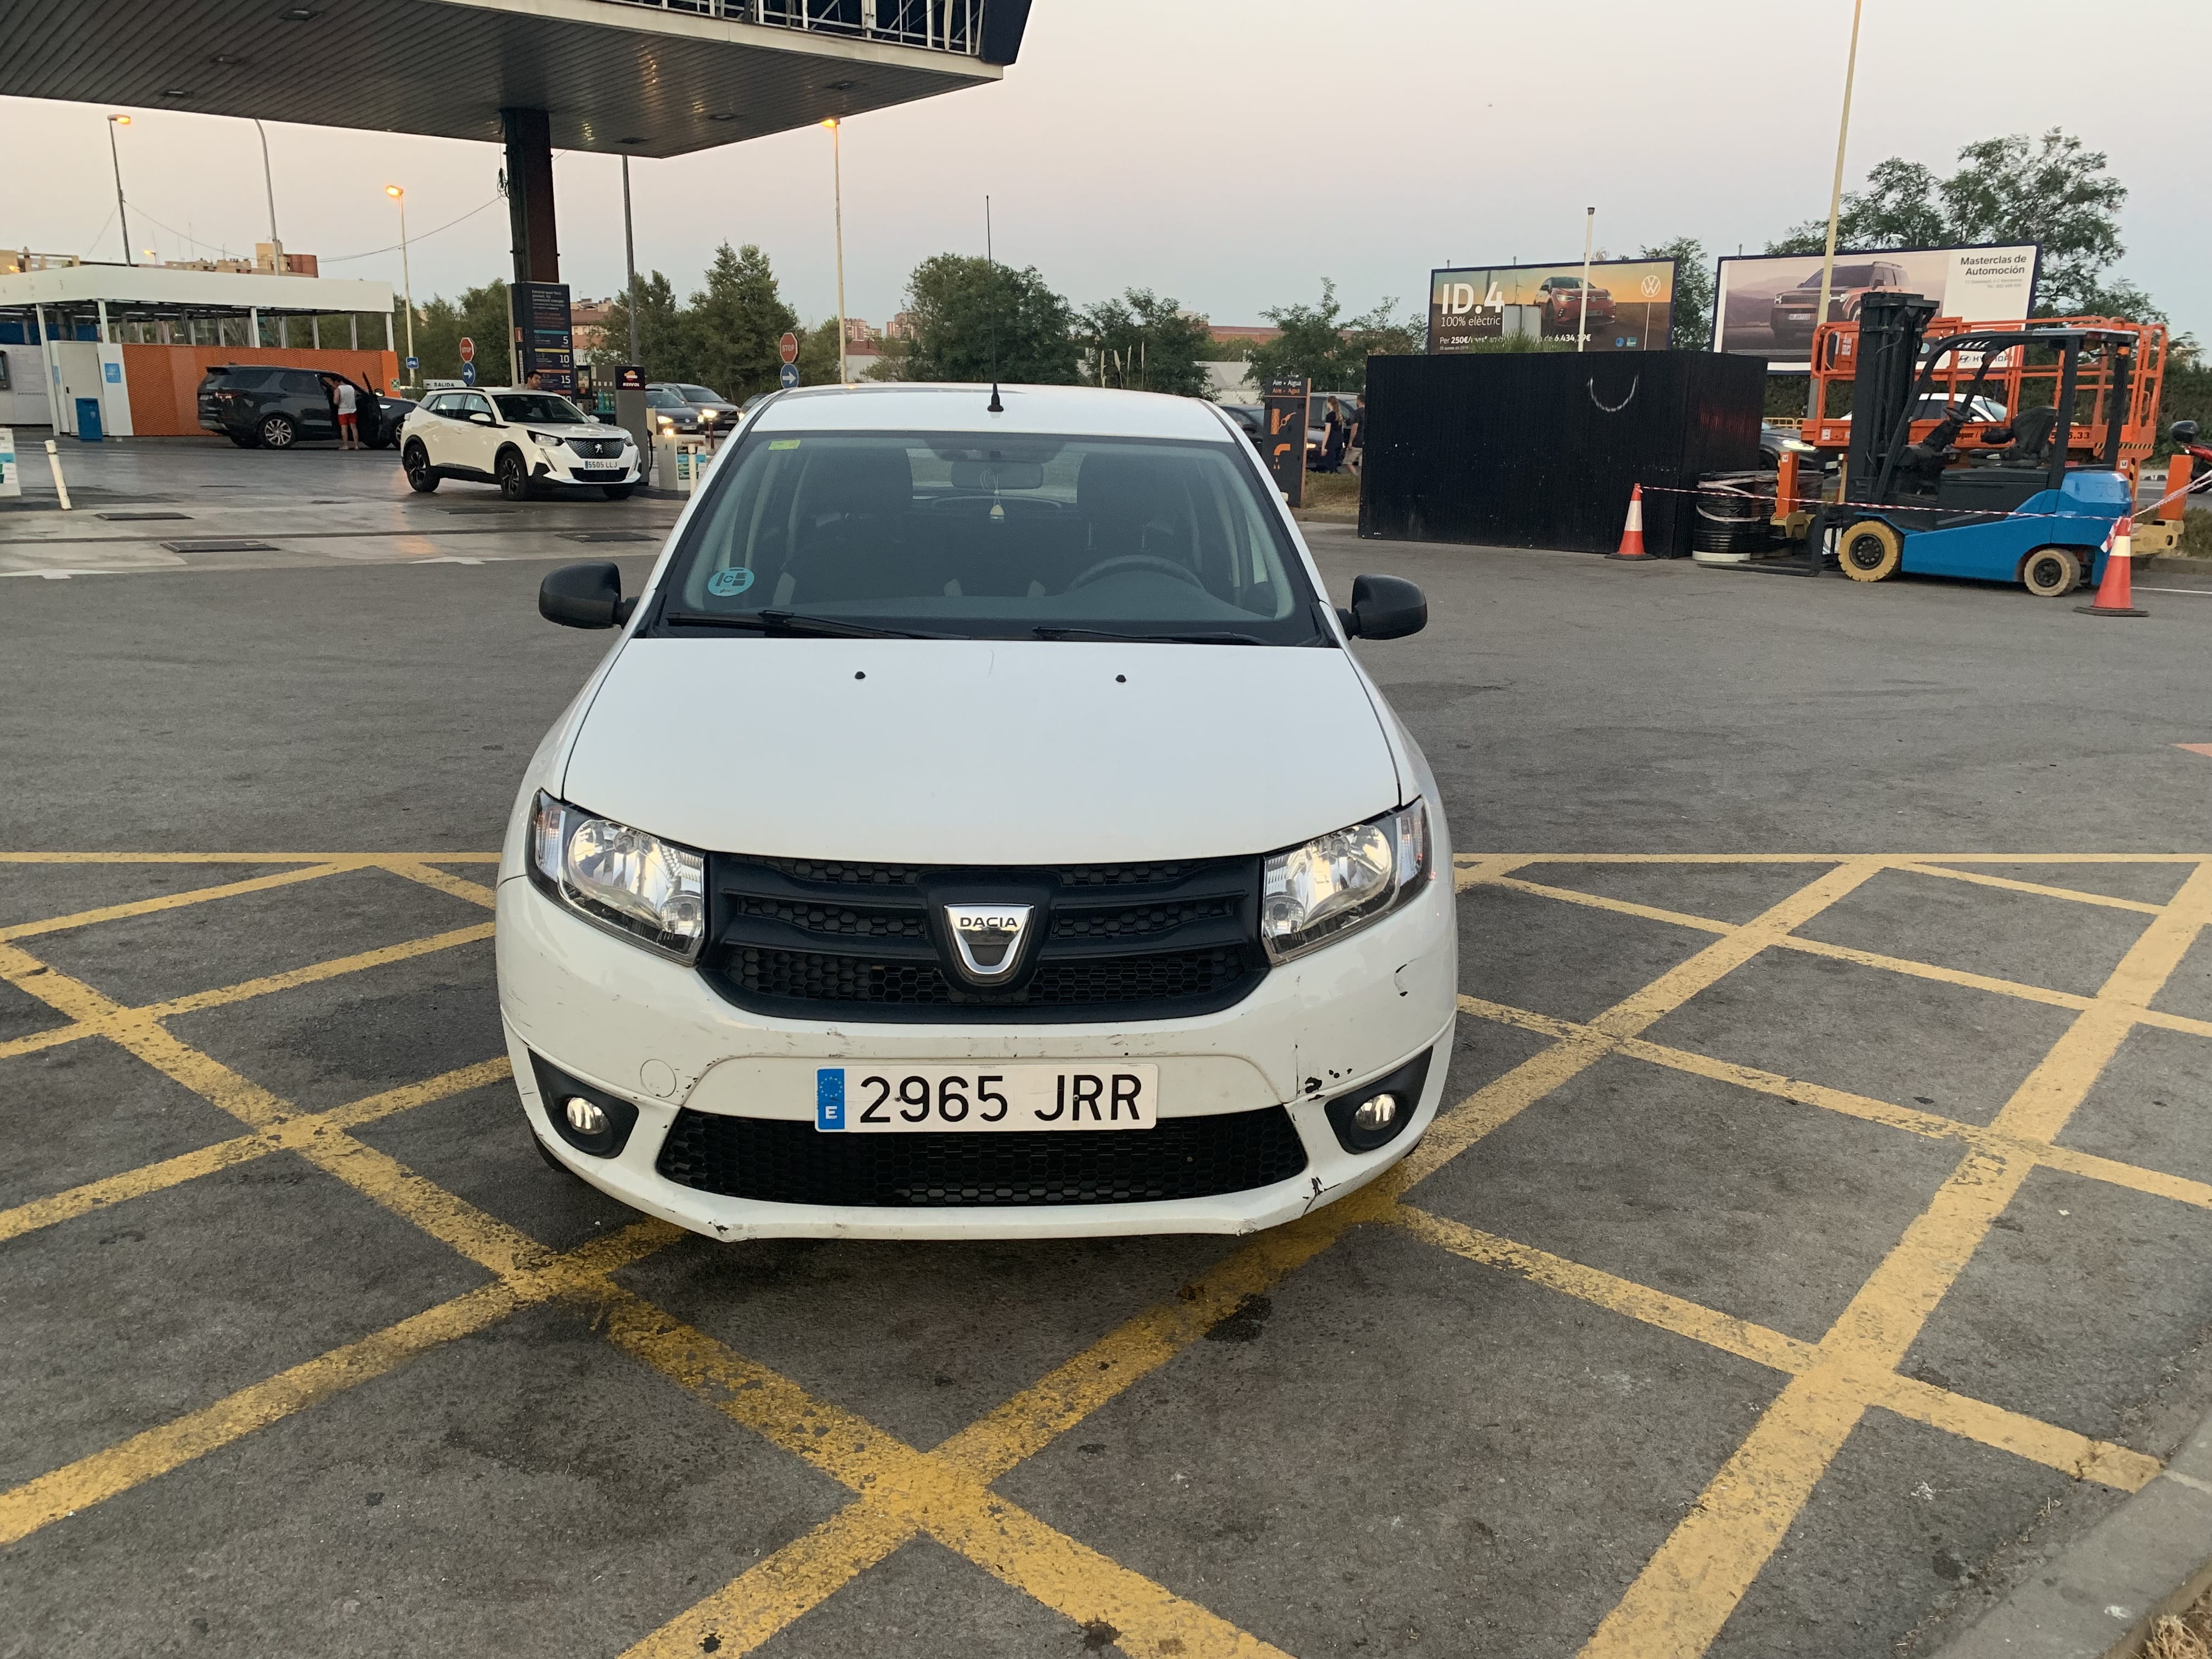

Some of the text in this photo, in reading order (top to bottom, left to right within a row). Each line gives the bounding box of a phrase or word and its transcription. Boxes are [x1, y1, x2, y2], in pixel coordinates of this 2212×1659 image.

[1960, 255, 2027, 266] Masterclas de
[1965, 265, 2025, 275] Automoción
[1442, 281, 1505, 315] ID.4
[1441, 315, 1501, 327] 100% elèctric
[563, 336, 568, 345] 5
[1440, 336, 1450, 345] Per
[560, 355, 570, 364] 10
[561, 375, 571, 384] 15
[960, 917, 1018, 927] DACIA
[825, 1074, 1142, 1123] E 2965 JRR
